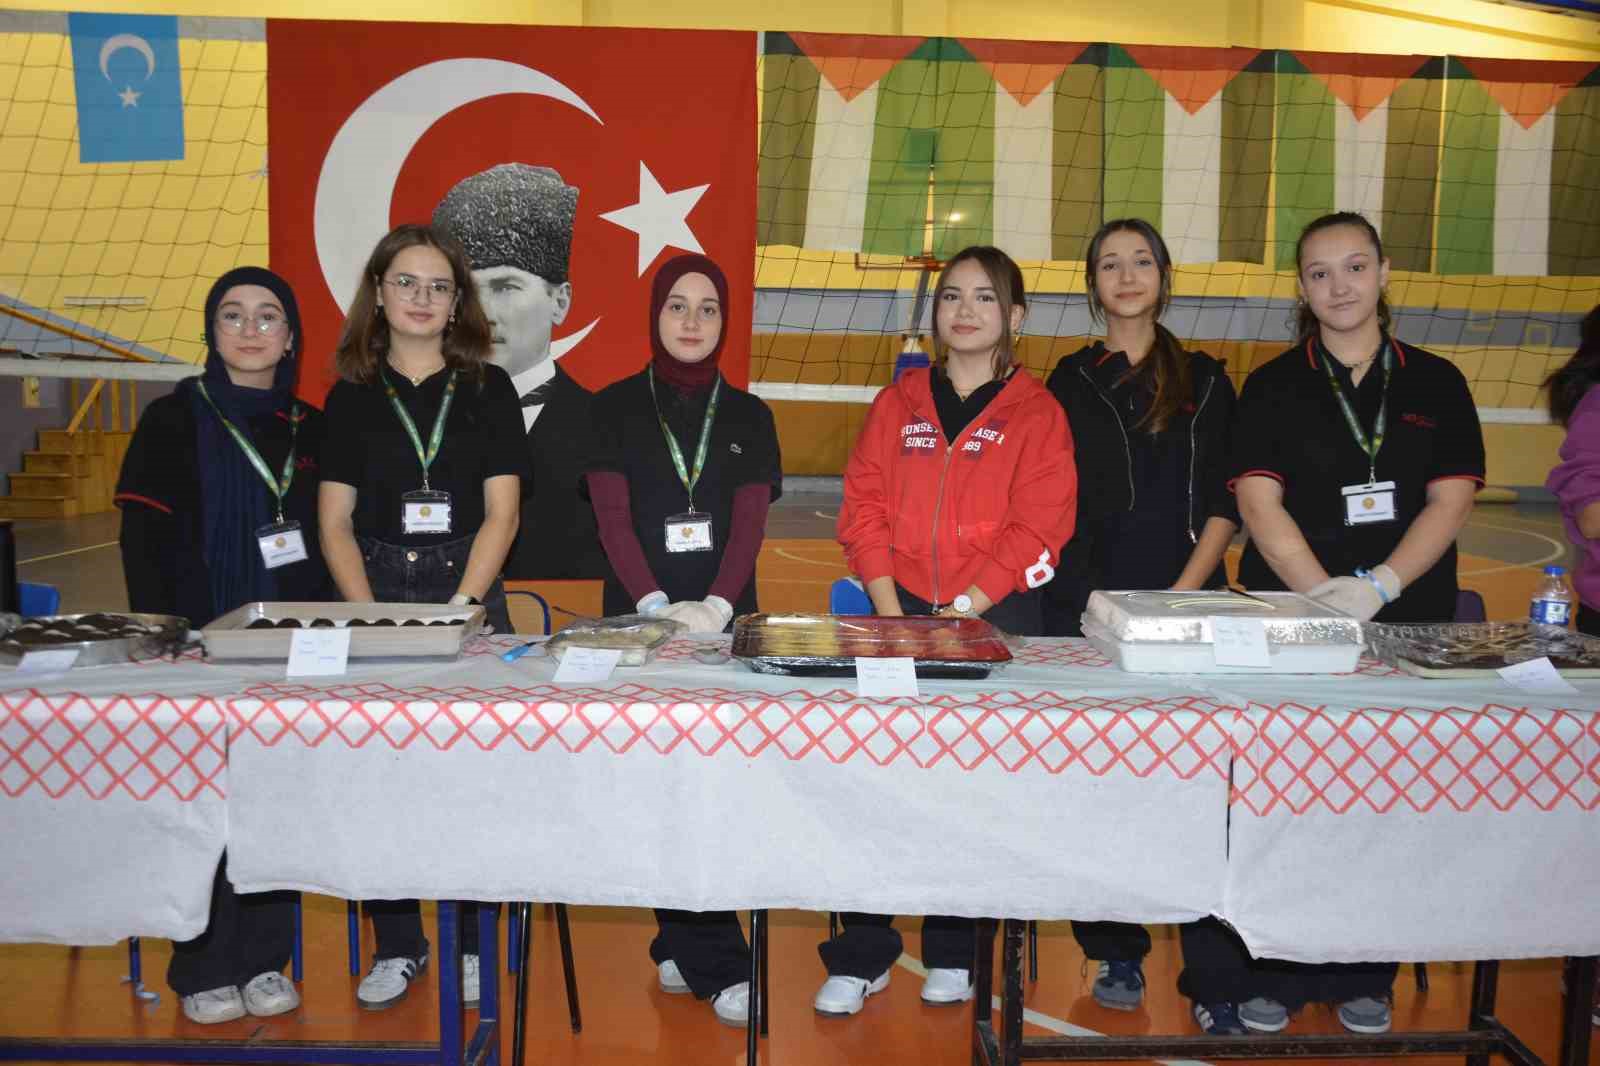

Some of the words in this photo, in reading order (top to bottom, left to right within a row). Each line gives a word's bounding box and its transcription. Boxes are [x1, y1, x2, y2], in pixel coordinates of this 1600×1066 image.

[900, 422, 938, 437] SUNSE
[970, 427, 1005, 445] ASE
[905, 436, 936, 448] SINCE
